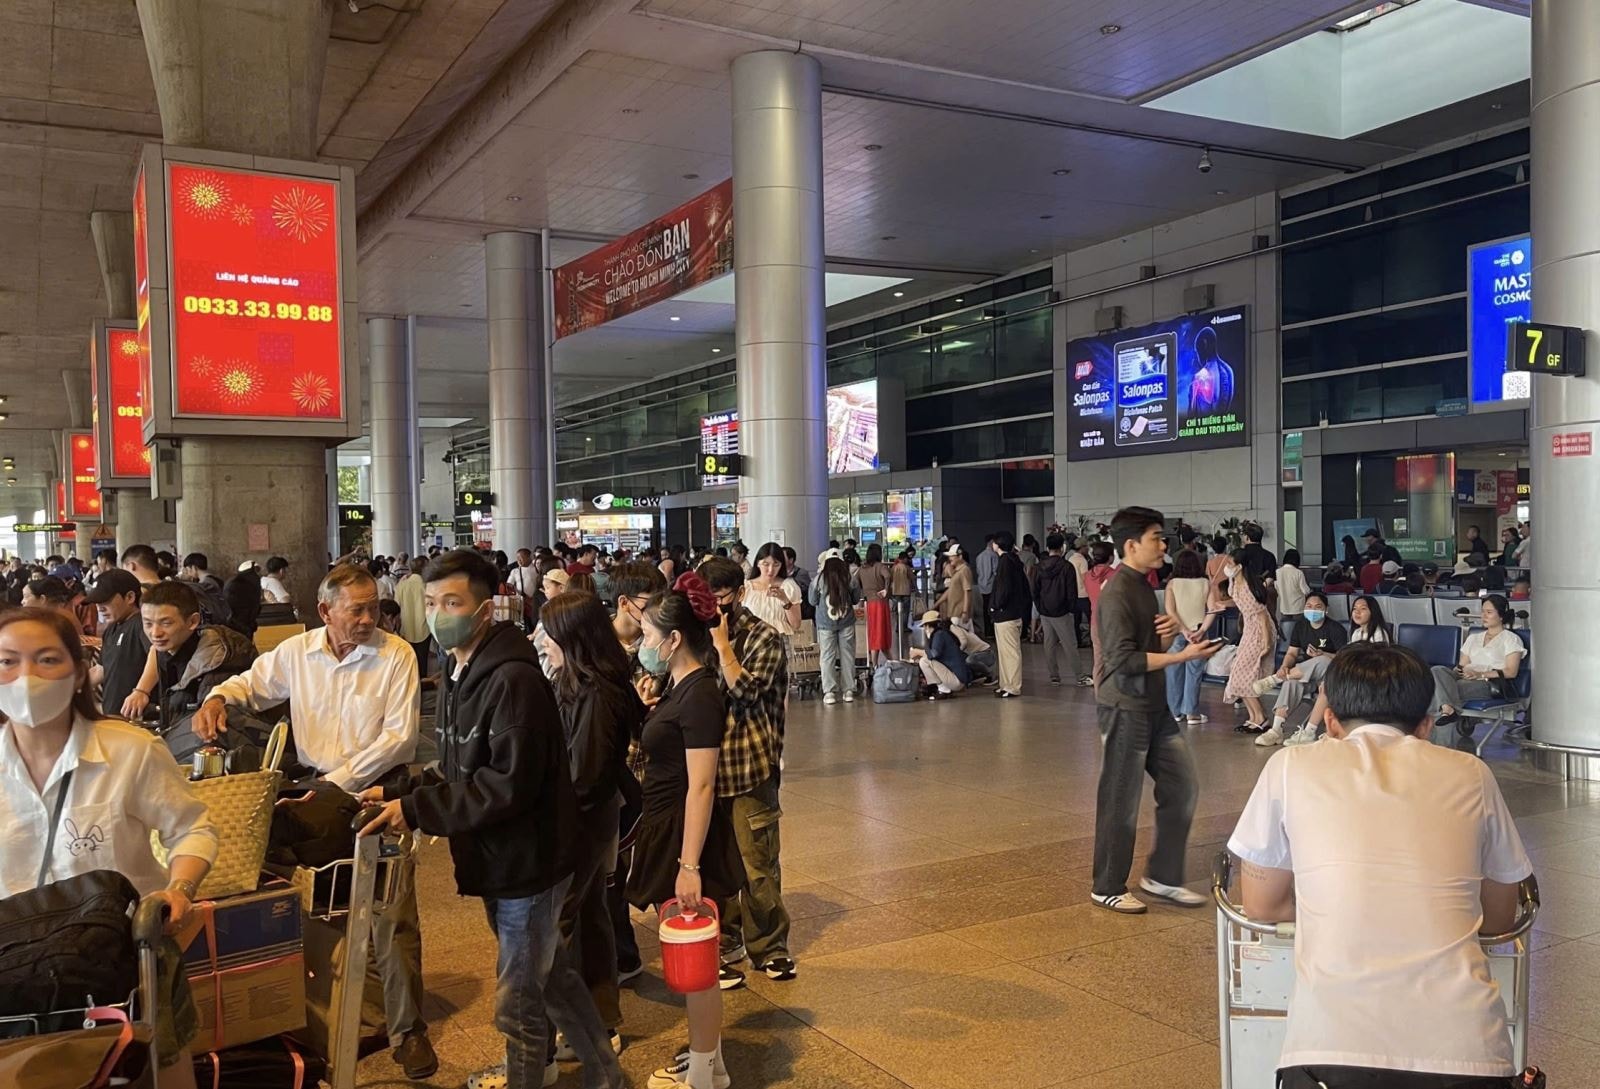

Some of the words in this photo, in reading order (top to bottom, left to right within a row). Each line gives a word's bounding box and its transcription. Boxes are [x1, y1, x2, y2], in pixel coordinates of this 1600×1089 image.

[605, 259, 634, 285] CHÀO
[637, 244, 662, 272] ĐÓN
[663, 218, 690, 260] BẠN
[216, 272, 236, 281] LIÊN
[238, 273, 249, 284] HỆ
[251, 274, 279, 285] QUẢNG
[281, 276, 299, 286] CÁO
[605, 283, 631, 305] WELCOME
[632, 279, 639, 294] TO
[640, 275, 648, 290] HO
[649, 270, 659, 287] CHI
[184, 295, 333, 322] 0933.33.99.88
[1526, 329, 1543, 364] 7
[1546, 353, 1560, 366] GF
[1073, 391, 1110, 407] Salonpas
[1123, 382, 1163, 399] Salonpas
[705, 455, 716, 473] 8
[464, 493, 473, 505] 9
[347, 510, 359, 520] 10
